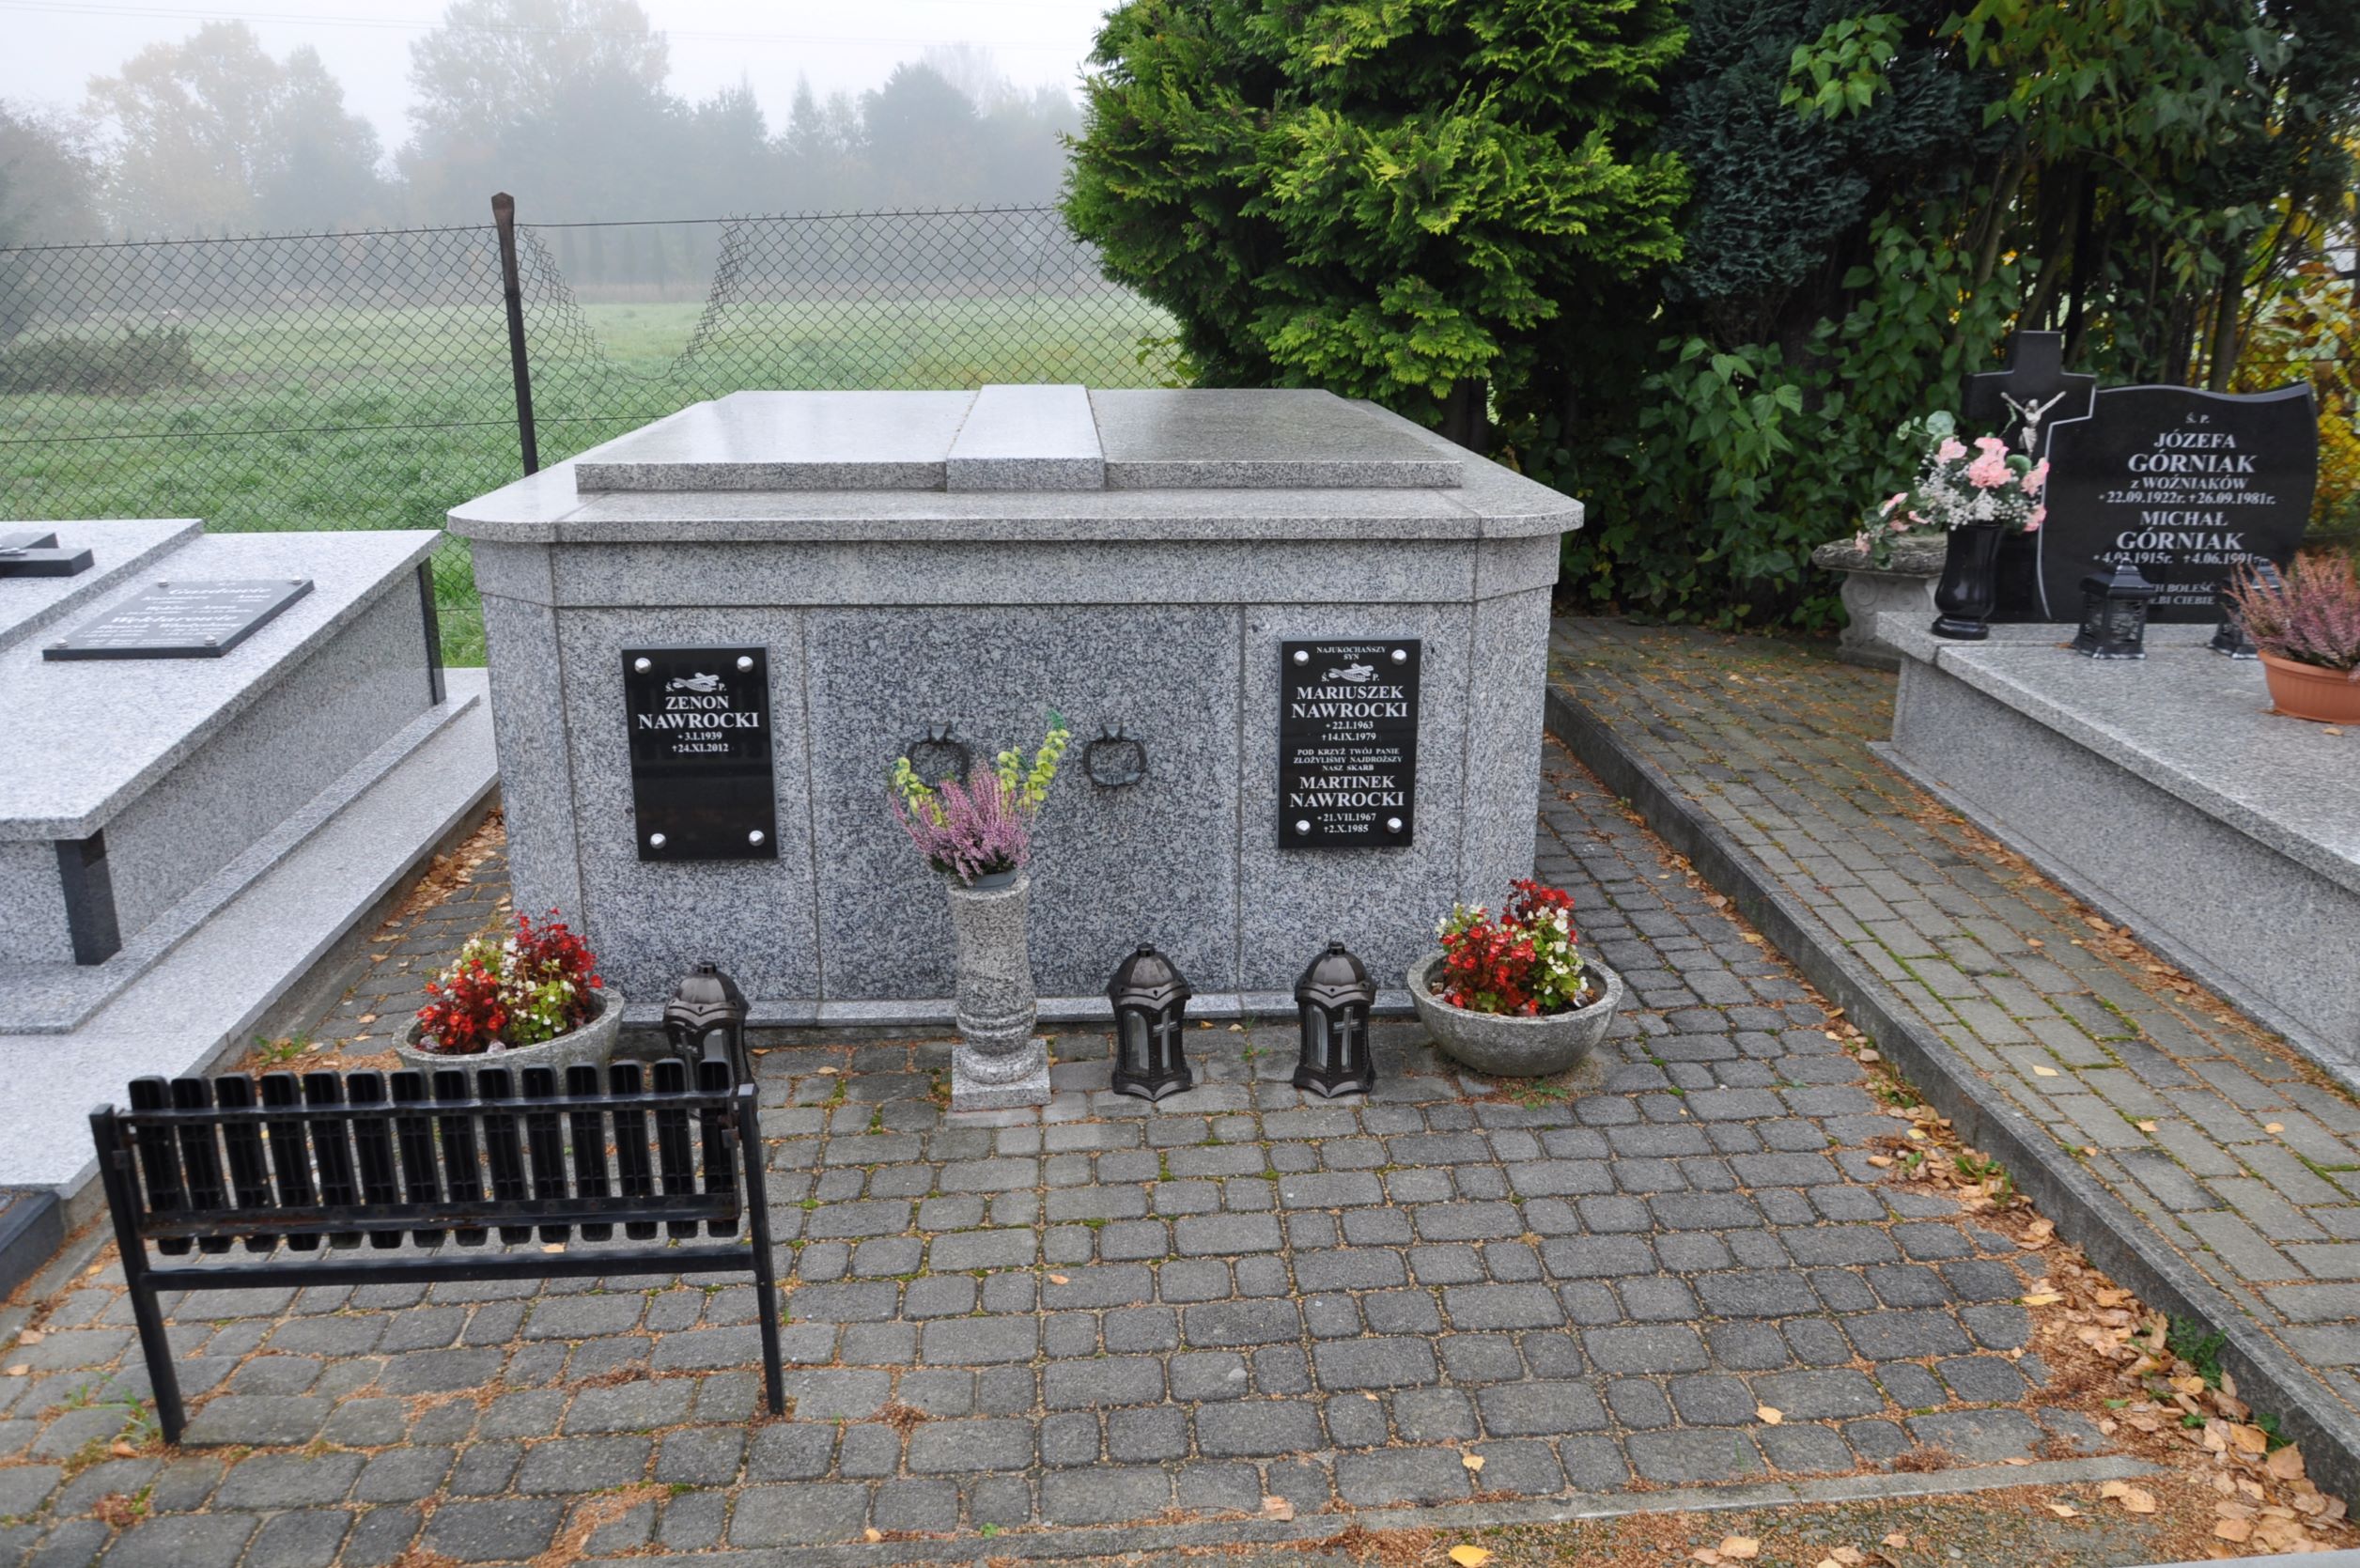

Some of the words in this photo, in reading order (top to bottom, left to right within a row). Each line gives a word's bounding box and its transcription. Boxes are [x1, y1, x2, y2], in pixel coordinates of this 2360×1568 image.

[2154, 428, 2236, 448] JÓZEFA
[2128, 450, 2258, 474] GÓRNIAK
[2142, 475, 2249, 489] WOŹNIAKÓW
[2140, 511, 2228, 526] MICHAŁ
[2116, 527, 2245, 550] GÓRNIAK
[2167, 582, 2215, 593] BOLEŚĆ
[2174, 596, 2214, 605] CIEBIE
[1296, 686, 1404, 700] MARIUSZEK
[666, 696, 729, 709] ZENON
[1291, 703, 1407, 718] NAWROCKI
[638, 712, 759, 729] NAWROCKI
[1350, 747, 1373, 755] TWÓJ
[1299, 775, 1396, 789] MARTINEK
[1290, 792, 1405, 807] NAWROCKI
